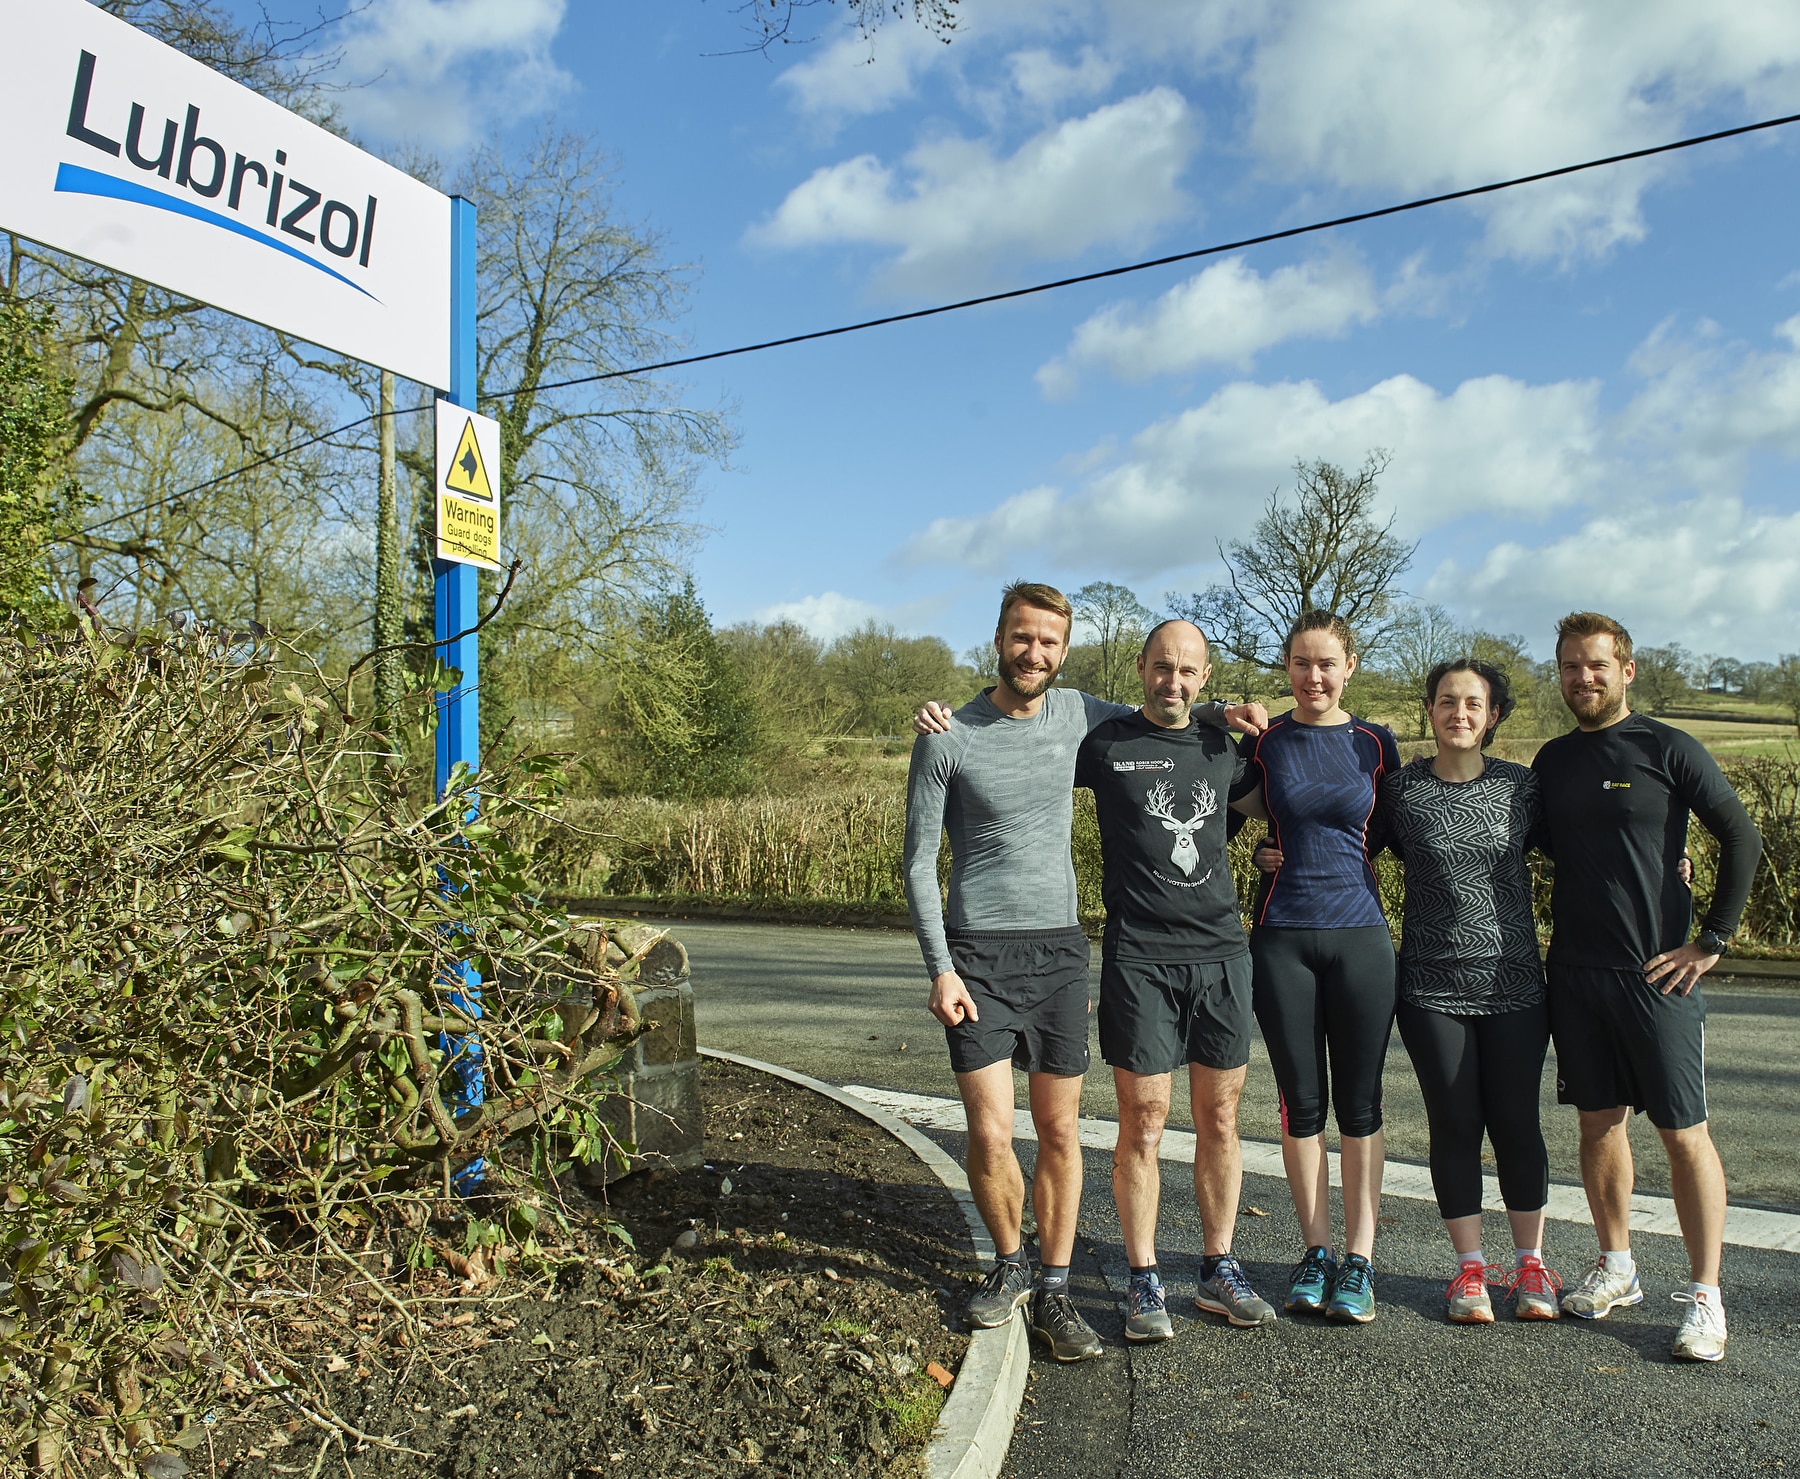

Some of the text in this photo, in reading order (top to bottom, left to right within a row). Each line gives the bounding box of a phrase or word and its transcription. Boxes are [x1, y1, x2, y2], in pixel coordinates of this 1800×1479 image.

[66, 49, 377, 268] Lubrizol
[445, 499, 494, 533] Warning
[447, 524, 491, 546] Guard dogs
[1153, 870, 1206, 887] RUN NOTTINGHAM
